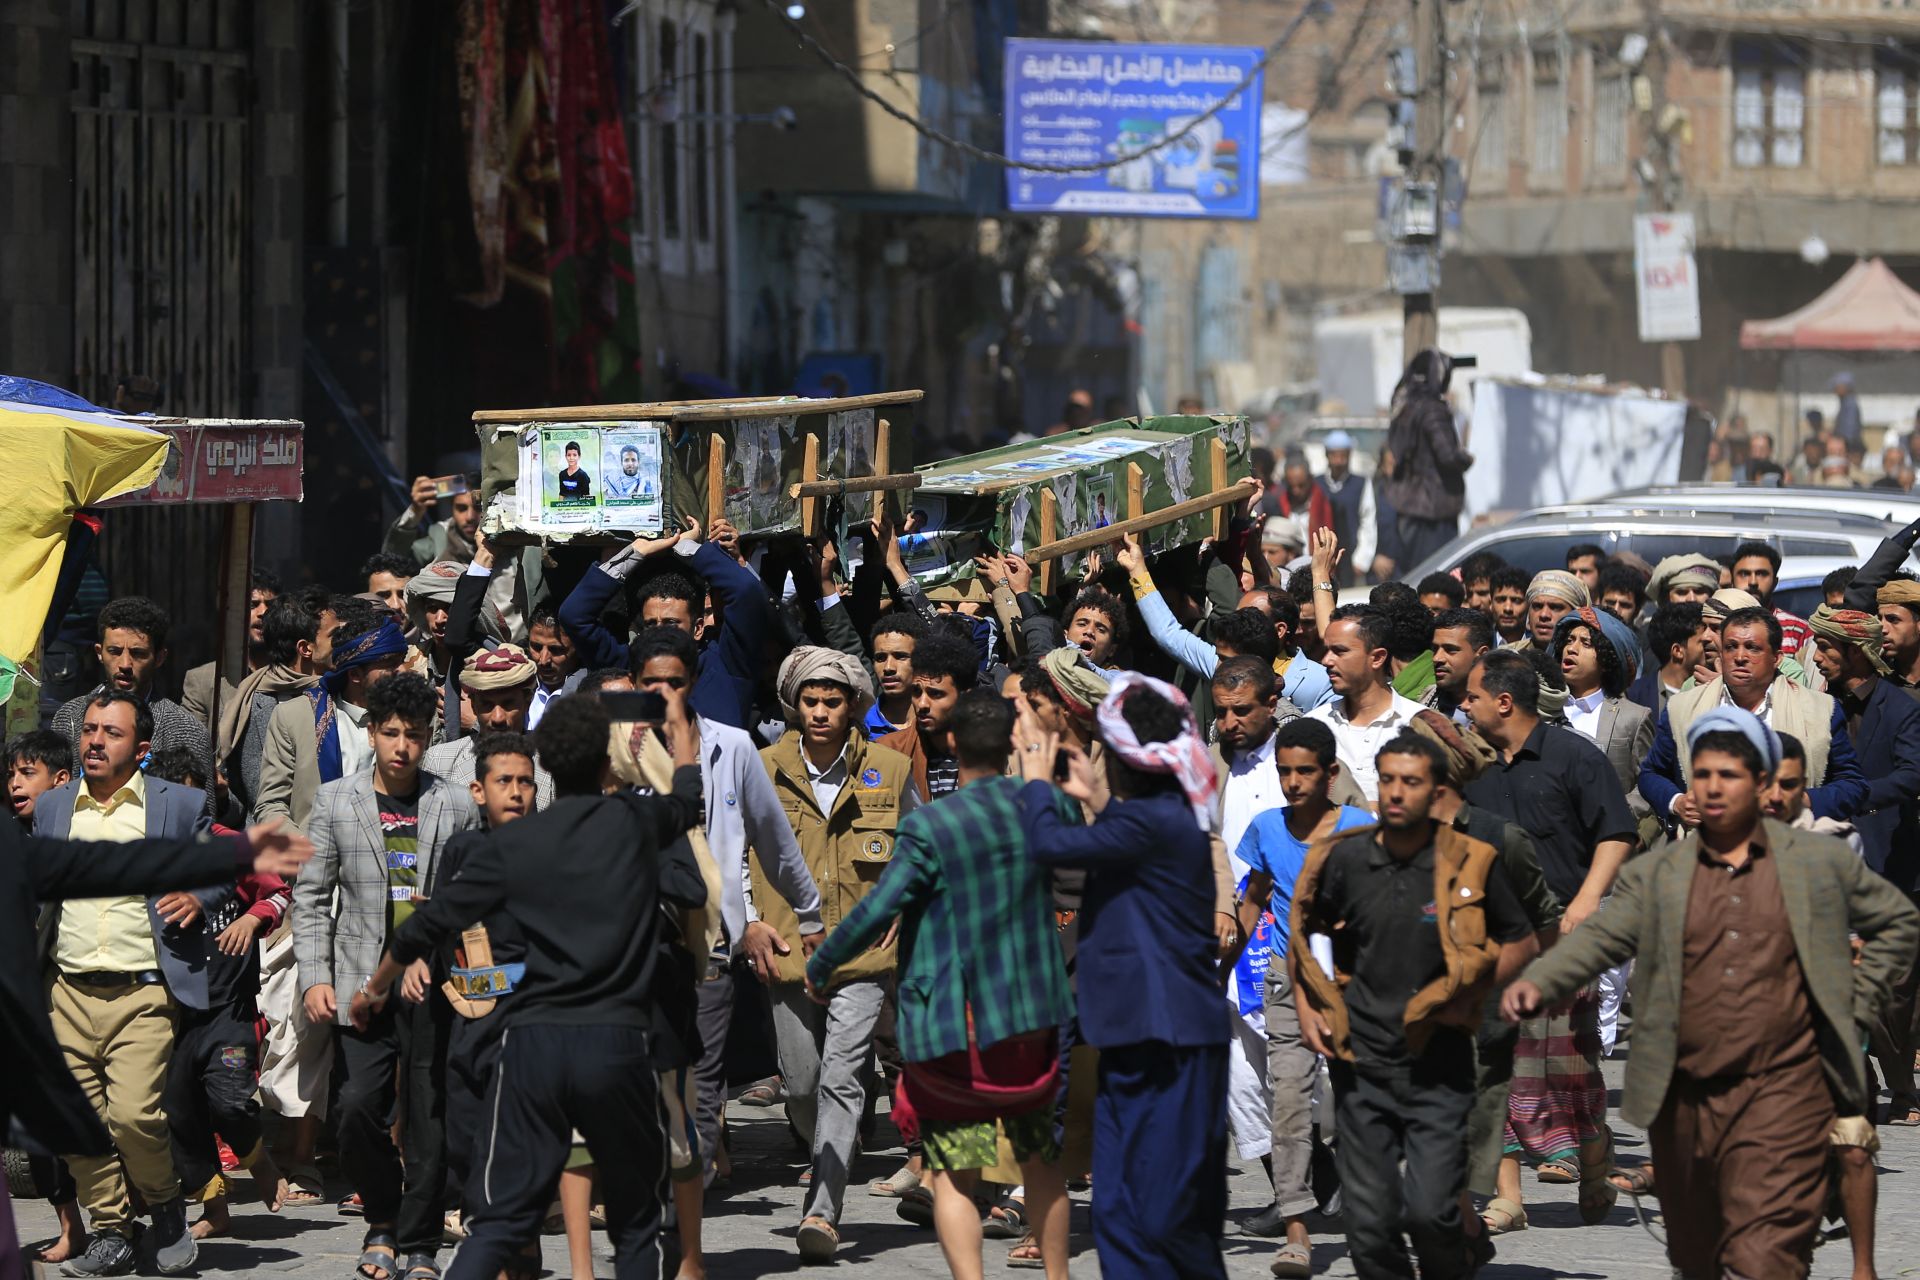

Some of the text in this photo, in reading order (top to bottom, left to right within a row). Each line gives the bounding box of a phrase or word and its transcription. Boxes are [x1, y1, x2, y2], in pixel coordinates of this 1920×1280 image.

[1022, 53, 1243, 87] مغاسل الأمل البخارية
[1020, 88, 1076, 108] الملابس
[1077, 87, 1111, 109] أنواع
[206, 432, 297, 476] ملك البرعي
[390, 888, 409, 899] ssFit
